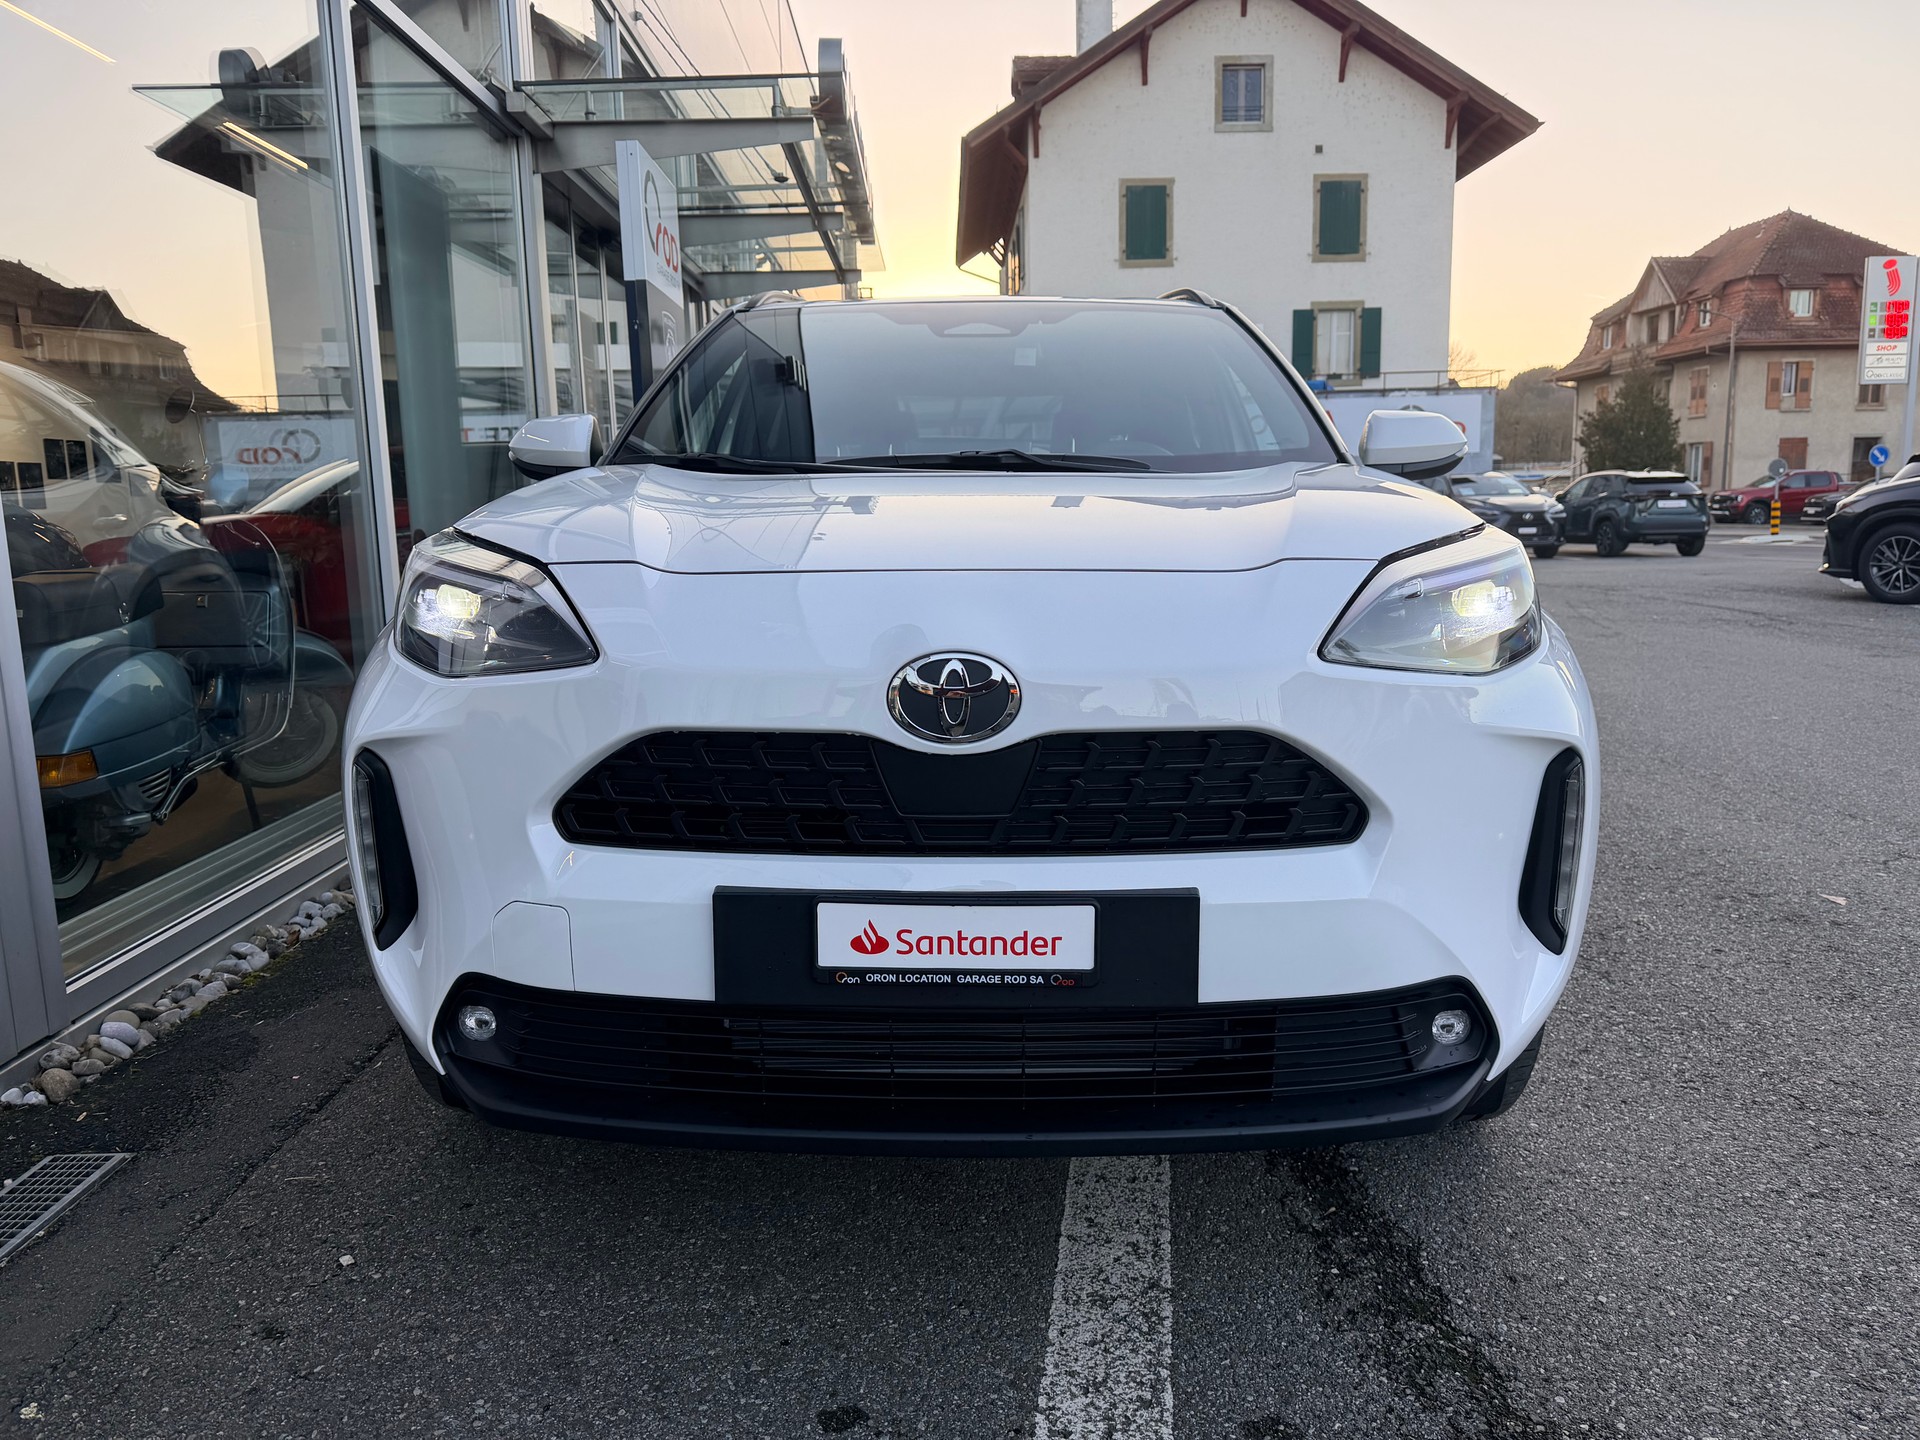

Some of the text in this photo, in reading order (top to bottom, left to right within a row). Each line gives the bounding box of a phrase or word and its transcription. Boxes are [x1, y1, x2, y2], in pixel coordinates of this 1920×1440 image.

[1875, 344, 1898, 352] SHOP
[895, 928, 1063, 956] Santander
[865, 973, 896, 983] ORON
[898, 973, 952, 983] LOCATION
[956, 974, 1002, 984] GARAGE
[1004, 975, 1027, 984] ROD
[1029, 975, 1044, 984] SA
